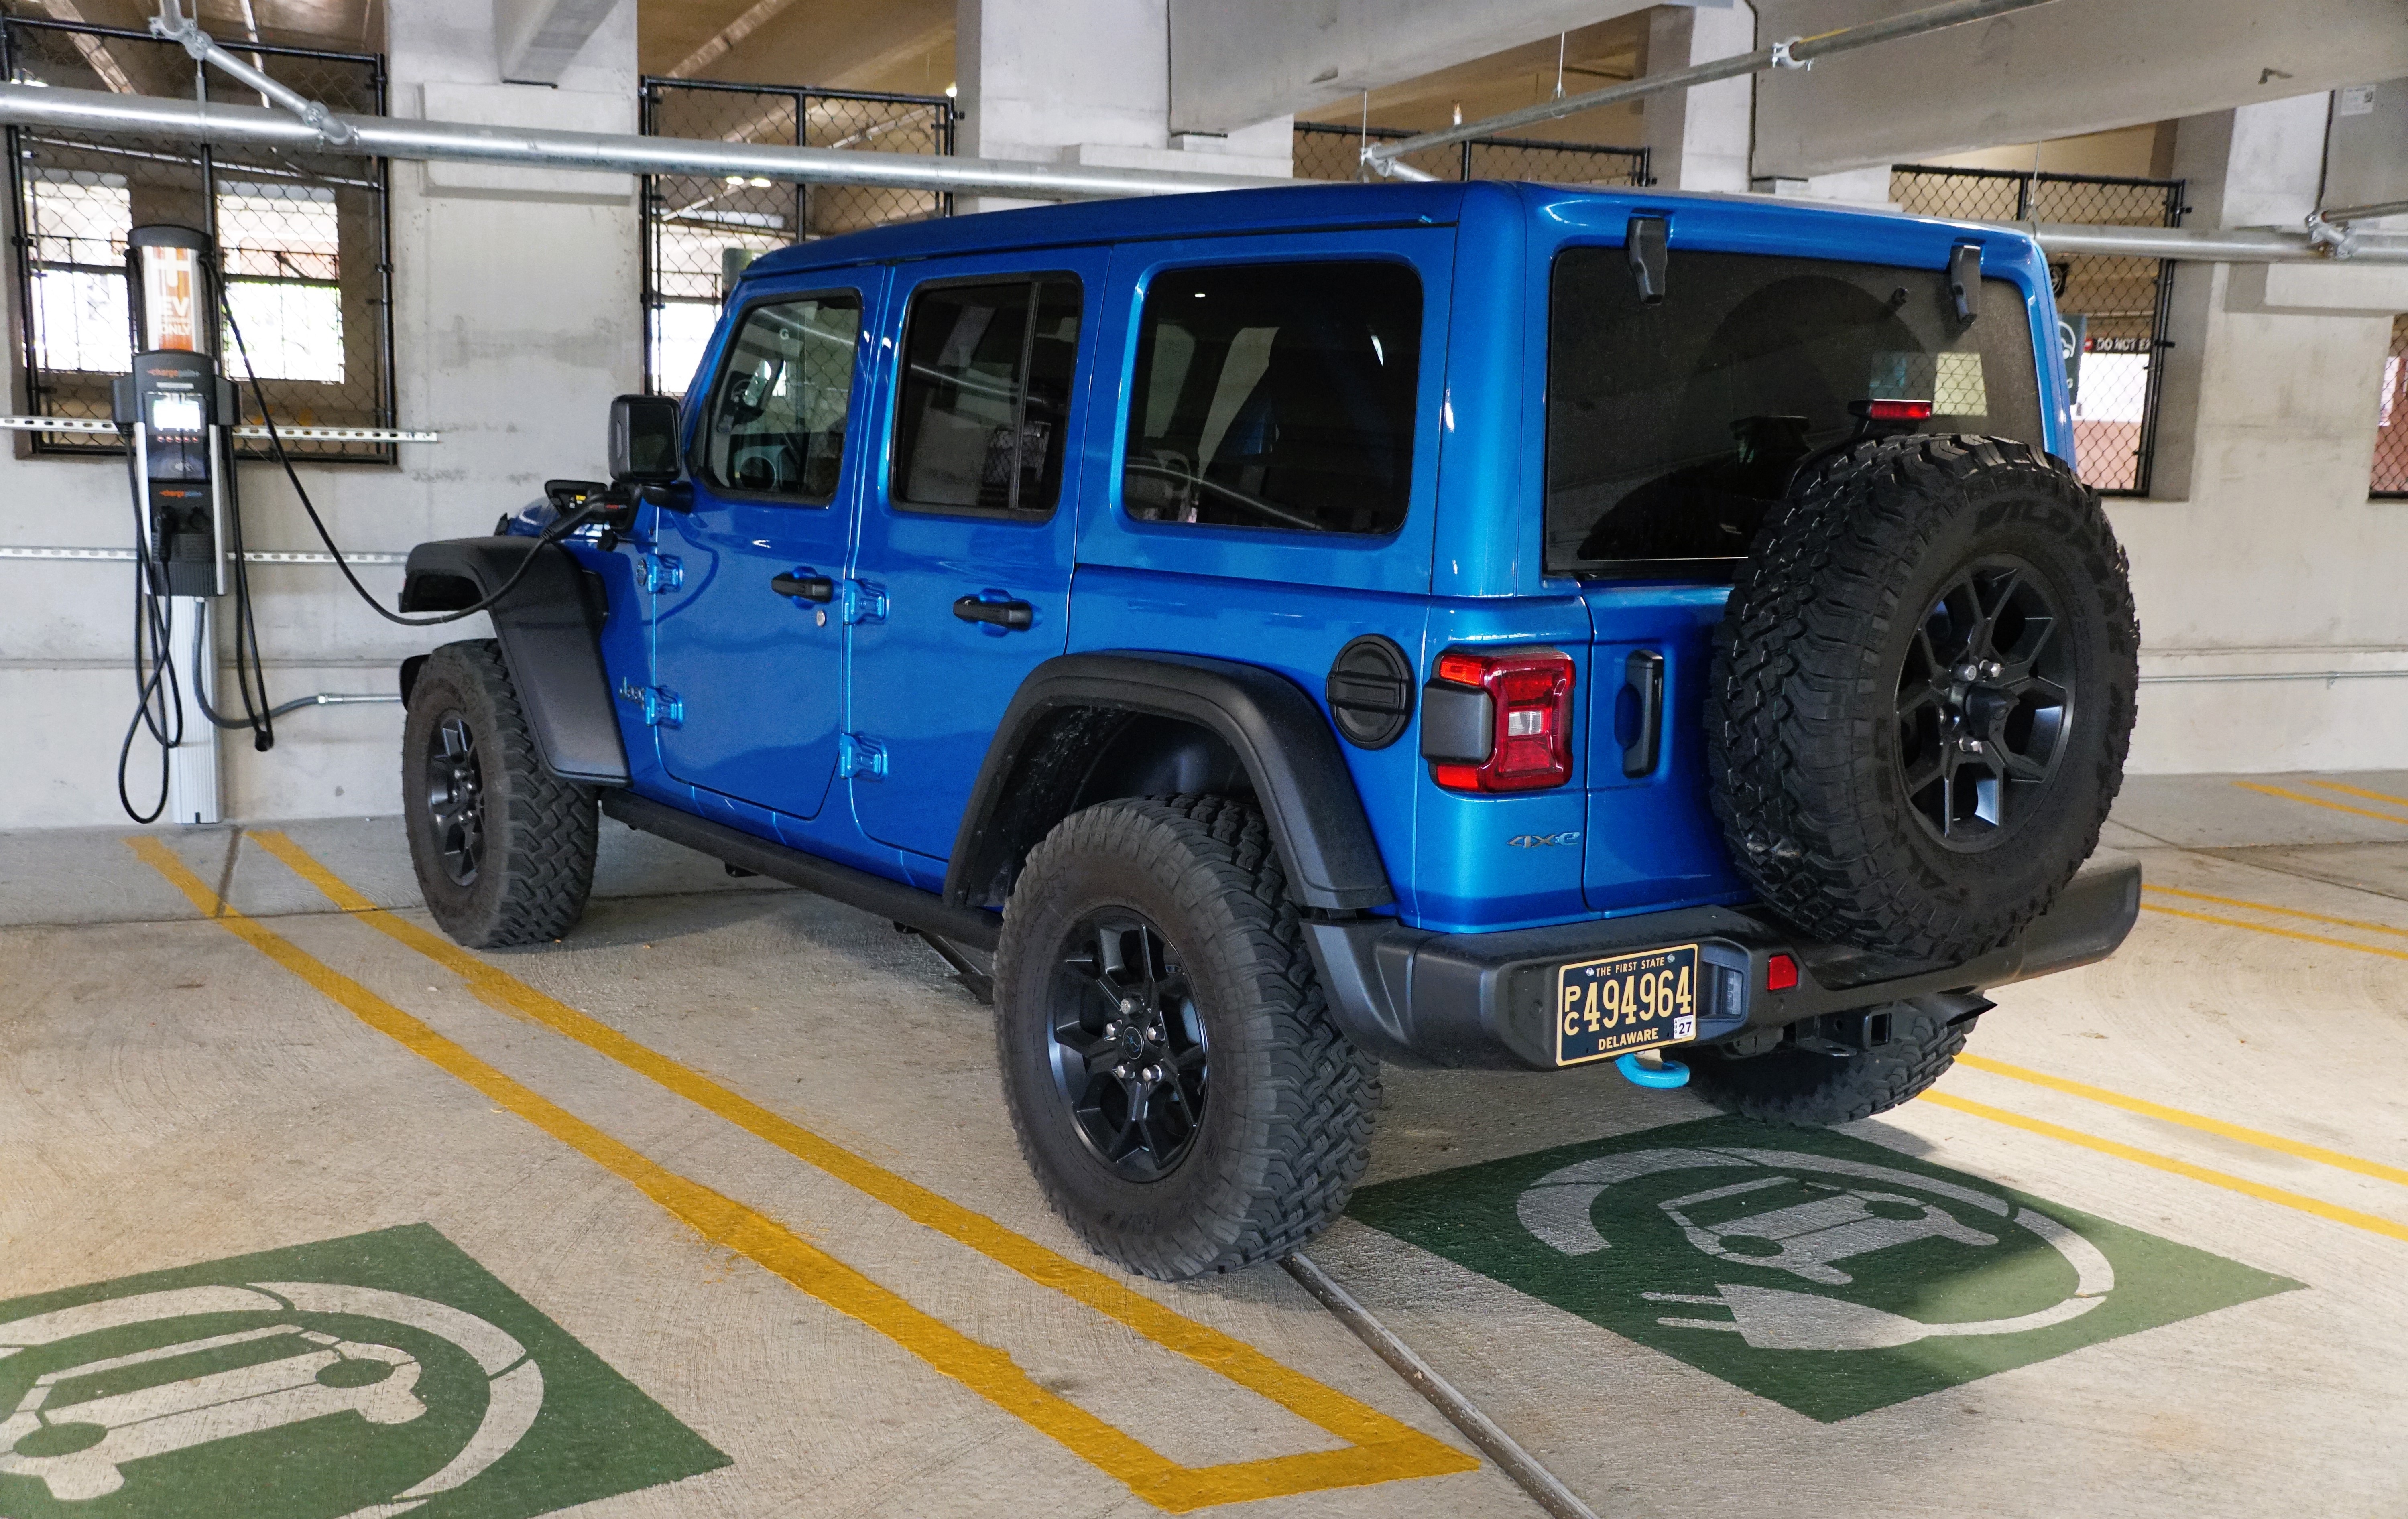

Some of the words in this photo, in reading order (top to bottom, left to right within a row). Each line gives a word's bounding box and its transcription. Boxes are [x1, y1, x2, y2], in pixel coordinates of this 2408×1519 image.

[162, 296, 190, 317] EV
[160, 323, 191, 335] ONLY
[2097, 337, 2113, 351] DO
[2114, 338, 2135, 351] NOT
[1506, 832, 1580, 849] 4xe
[1596, 966, 1611, 977] THE
[1615, 961, 1637, 974] FIRST
[1641, 957, 1665, 969] STATE
[1583, 966, 1692, 1032] 494964
[1679, 1021, 1692, 1034] 27
[1598, 1028, 1658, 1050] DELAWARE
